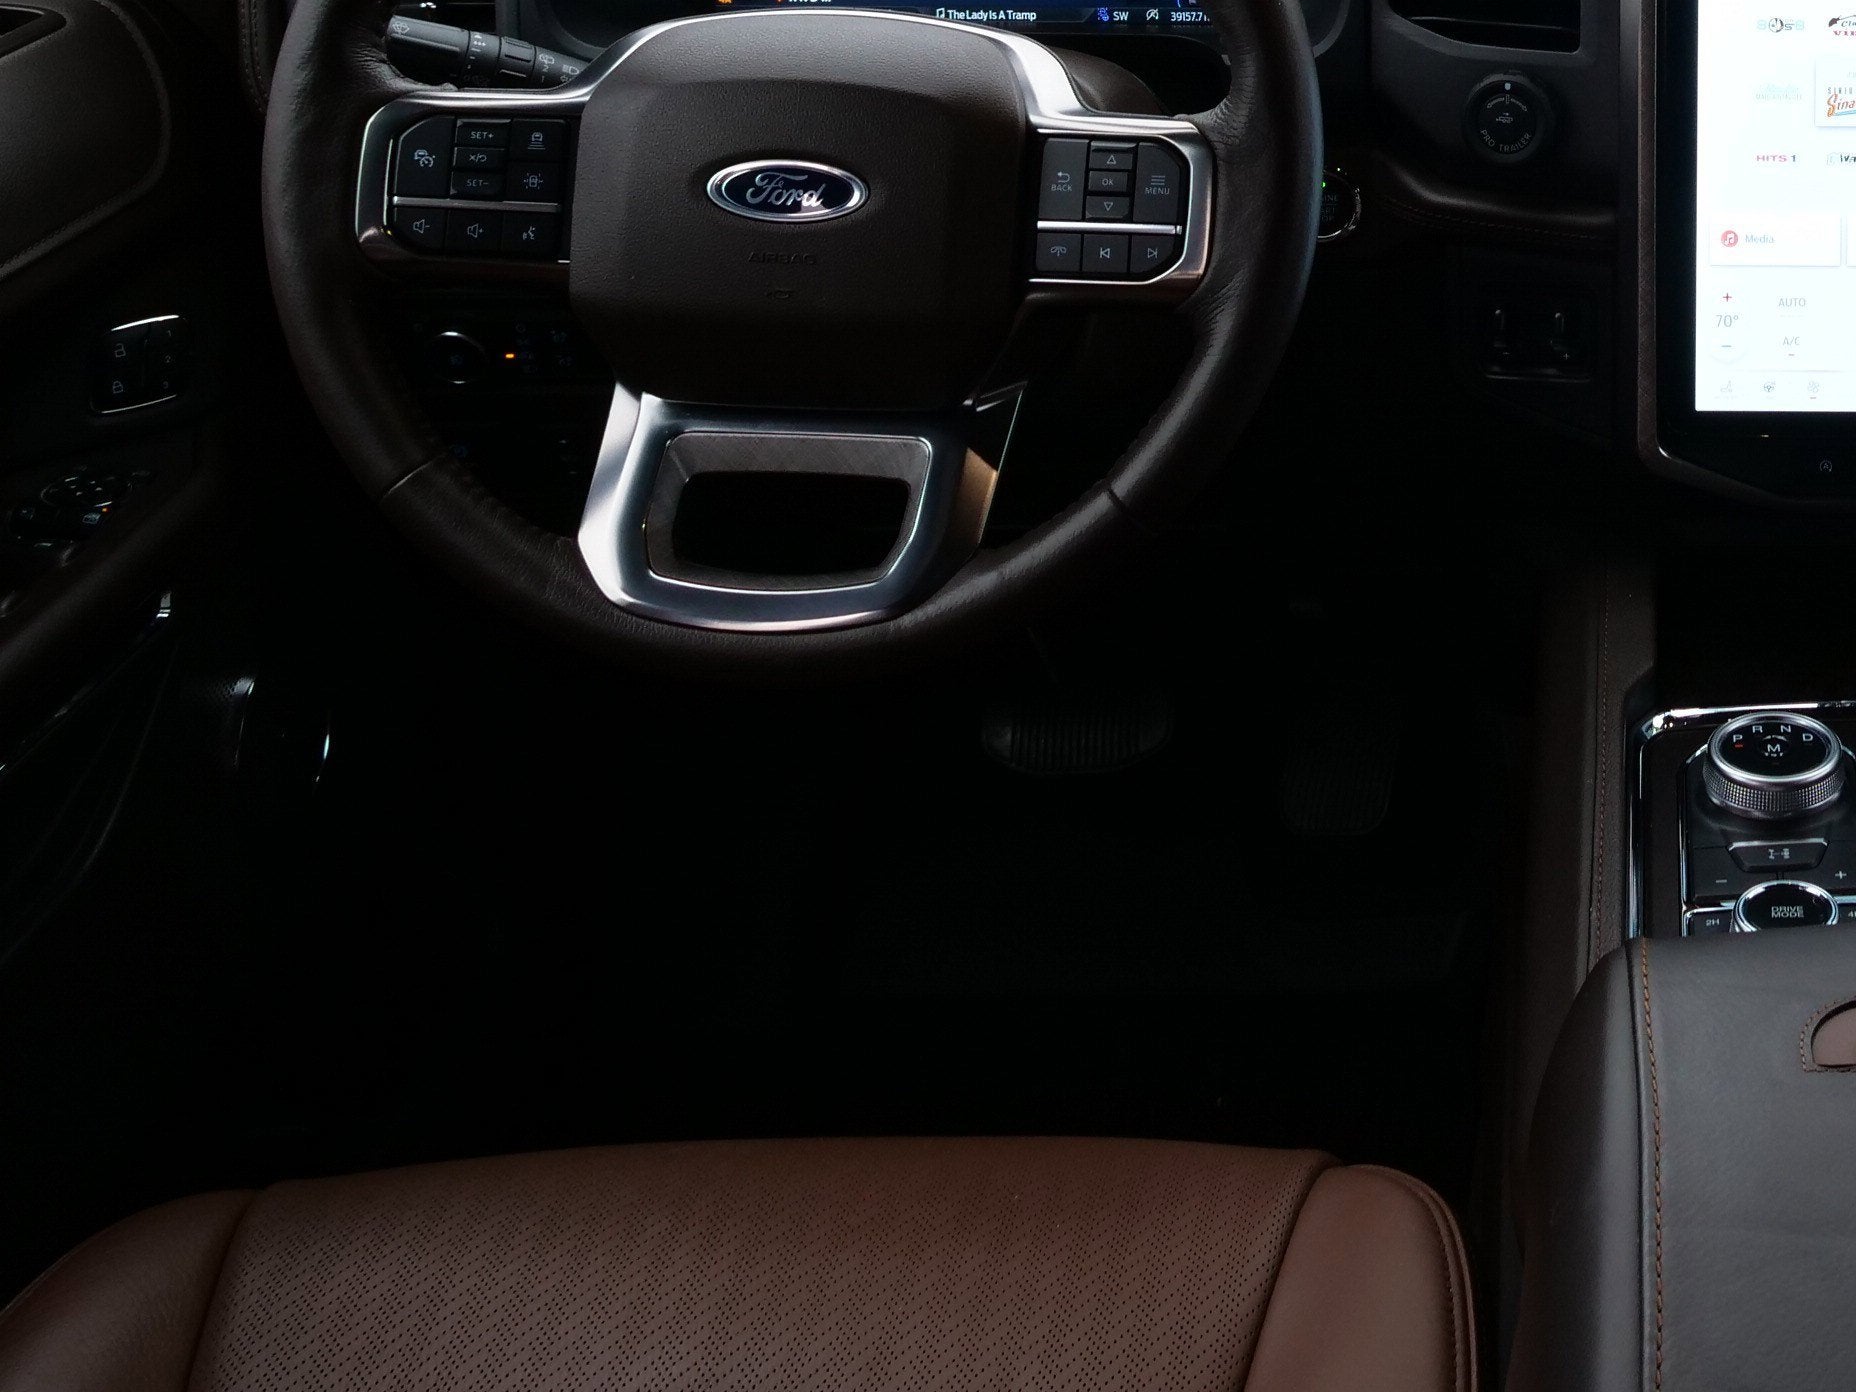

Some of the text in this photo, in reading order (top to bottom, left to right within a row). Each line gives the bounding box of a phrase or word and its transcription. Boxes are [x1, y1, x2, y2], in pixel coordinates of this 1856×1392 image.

[947, 9, 1037, 22] The Lady Is A Tramp
[1113, 11, 1129, 22] SW
[1756, 154, 1787, 162] HITS
[1051, 183, 1073, 192] BACK
[1144, 187, 1171, 196] MENU
[1744, 233, 1775, 244] Media
[1778, 297, 1807, 308] AUTO
[1752, 724, 1763, 733] R
[1780, 724, 1792, 733] N
[1732, 734, 1743, 744] P
[1802, 733, 1814, 742] D
[1767, 743, 1781, 753] M
